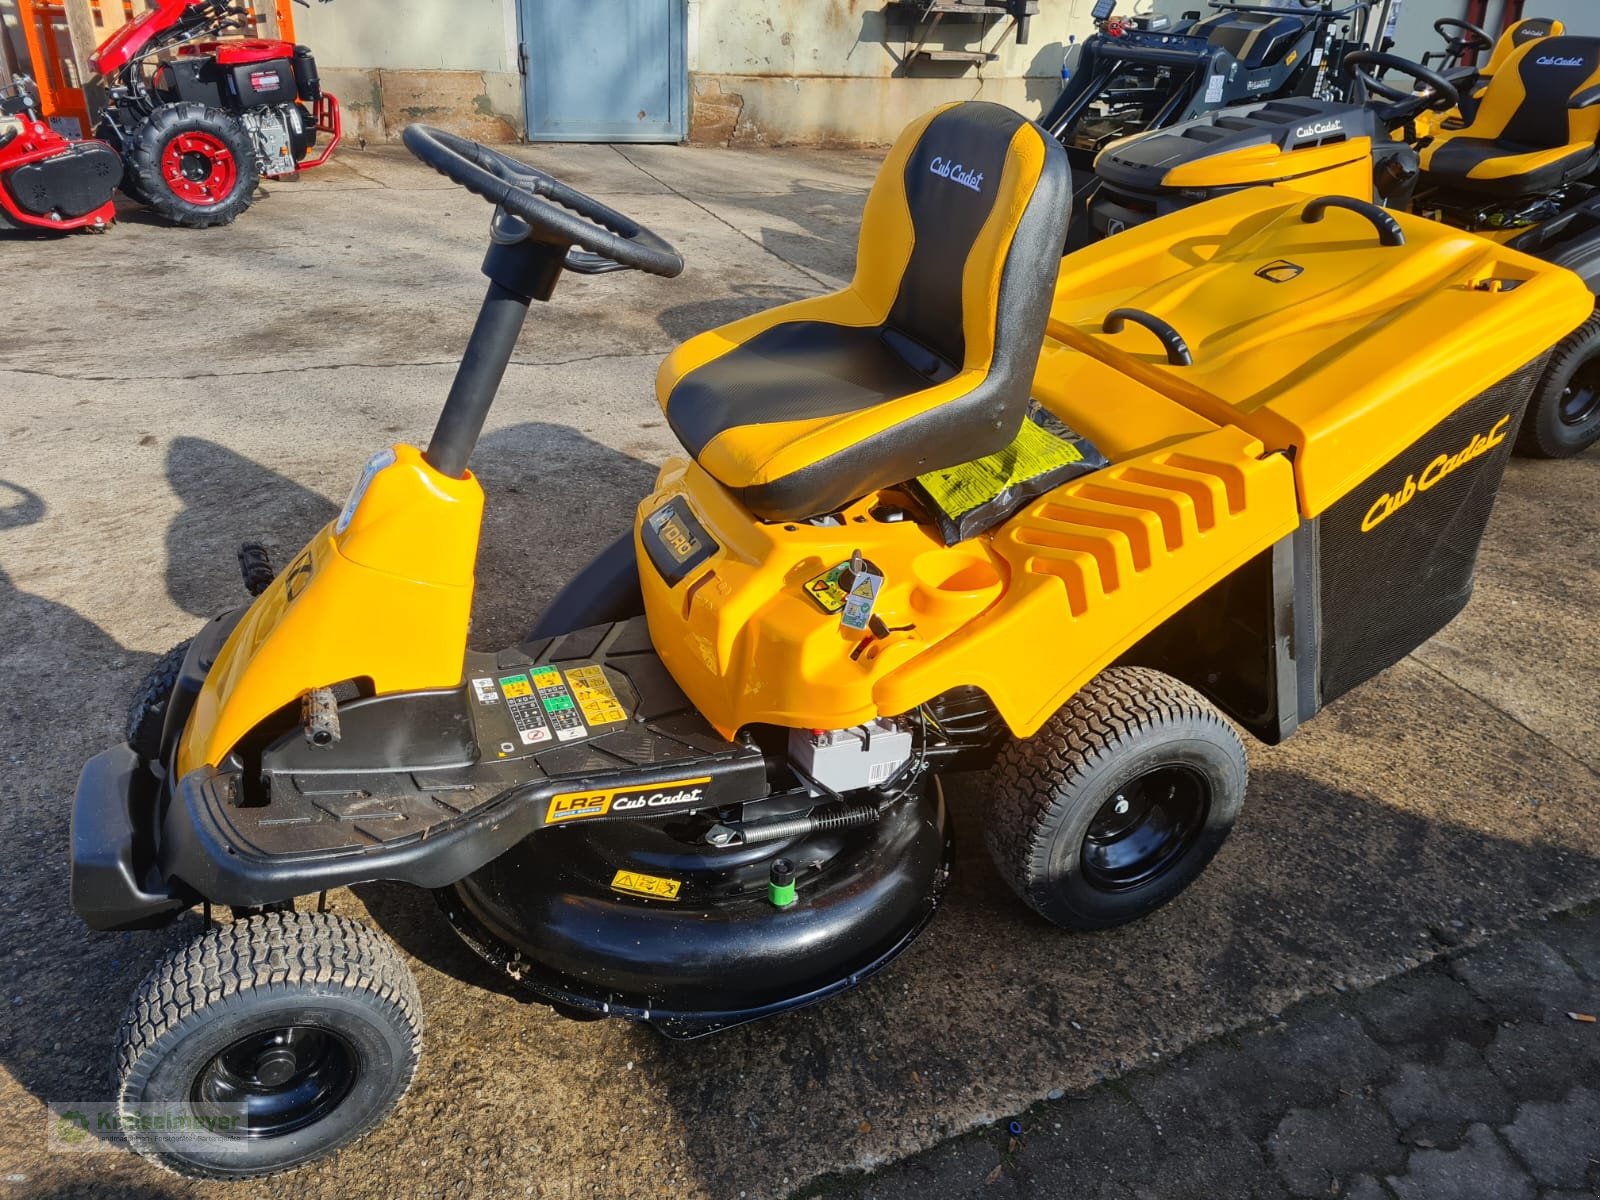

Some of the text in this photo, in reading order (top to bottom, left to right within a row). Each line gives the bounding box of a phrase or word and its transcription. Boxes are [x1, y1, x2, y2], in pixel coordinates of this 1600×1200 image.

[1536, 56, 1584, 66] Cub Cadet
[1296, 119, 1343, 138] Cub Cadet
[930, 156, 984, 192] Cub Cadet
[1361, 414, 1510, 533] Cub Cadet
[554, 796, 606, 812] LR2
[612, 788, 703, 811] Cub Cadet
